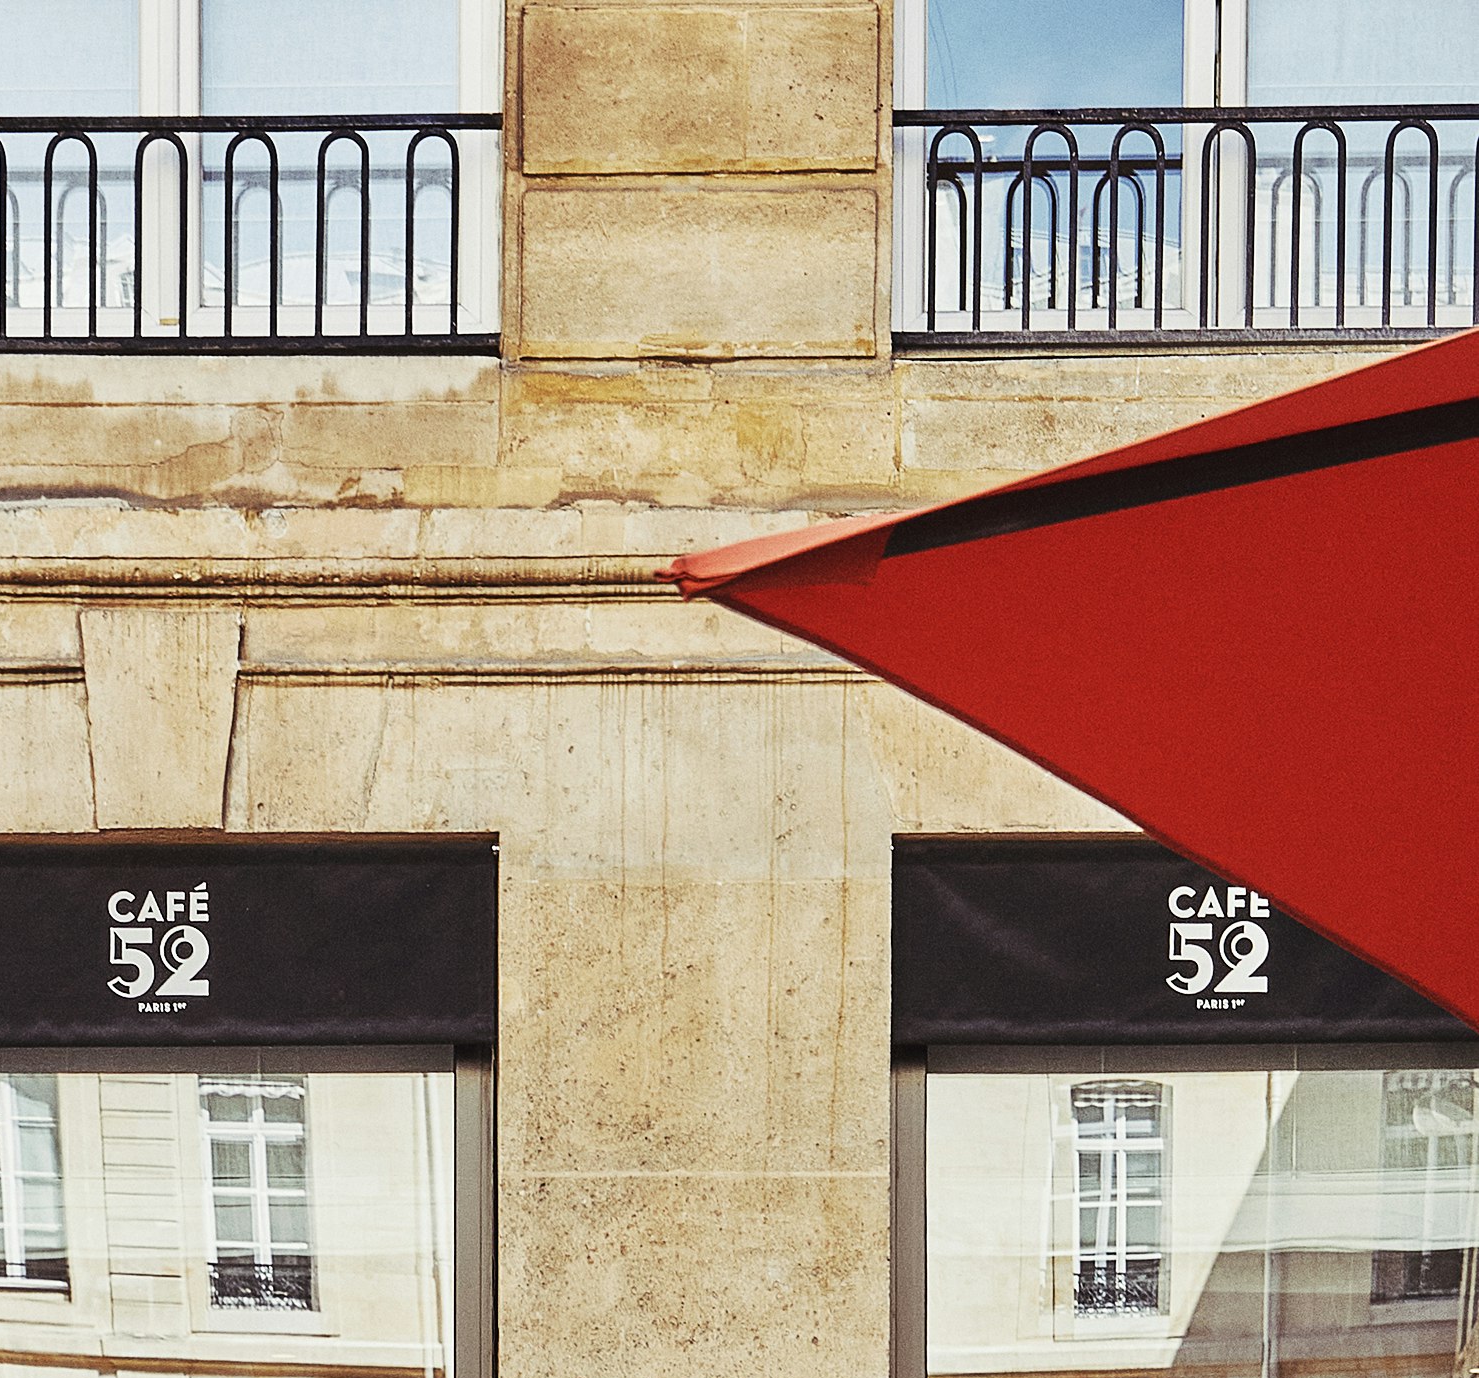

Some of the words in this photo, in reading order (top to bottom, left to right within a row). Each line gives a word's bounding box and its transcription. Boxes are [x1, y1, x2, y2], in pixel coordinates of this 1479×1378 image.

[107, 882, 210, 923] CAFÉ
[107, 925, 210, 999] 52
[1165, 920, 1270, 995] 52
[138, 1002, 170, 1013] PARIS
[1196, 999, 1229, 1009] PARIS
